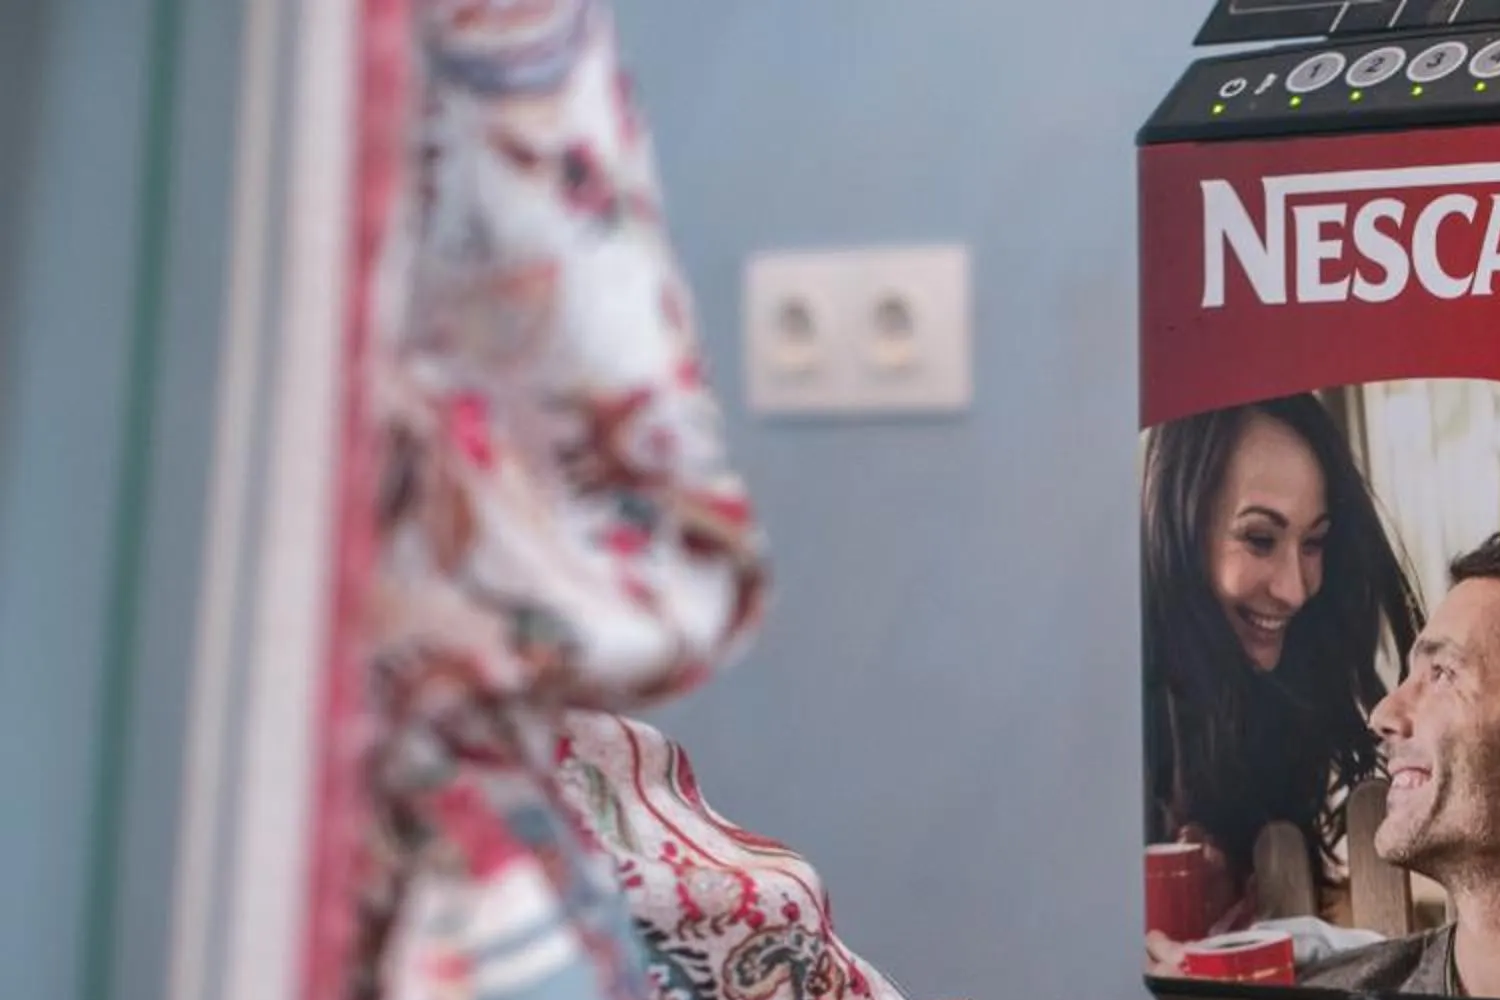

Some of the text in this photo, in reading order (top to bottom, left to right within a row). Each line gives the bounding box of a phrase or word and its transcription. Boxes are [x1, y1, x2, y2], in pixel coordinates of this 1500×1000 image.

[1308, 62, 1323, 80] 1
[1364, 55, 1386, 74] 2
[1425, 50, 1446, 69] 3
